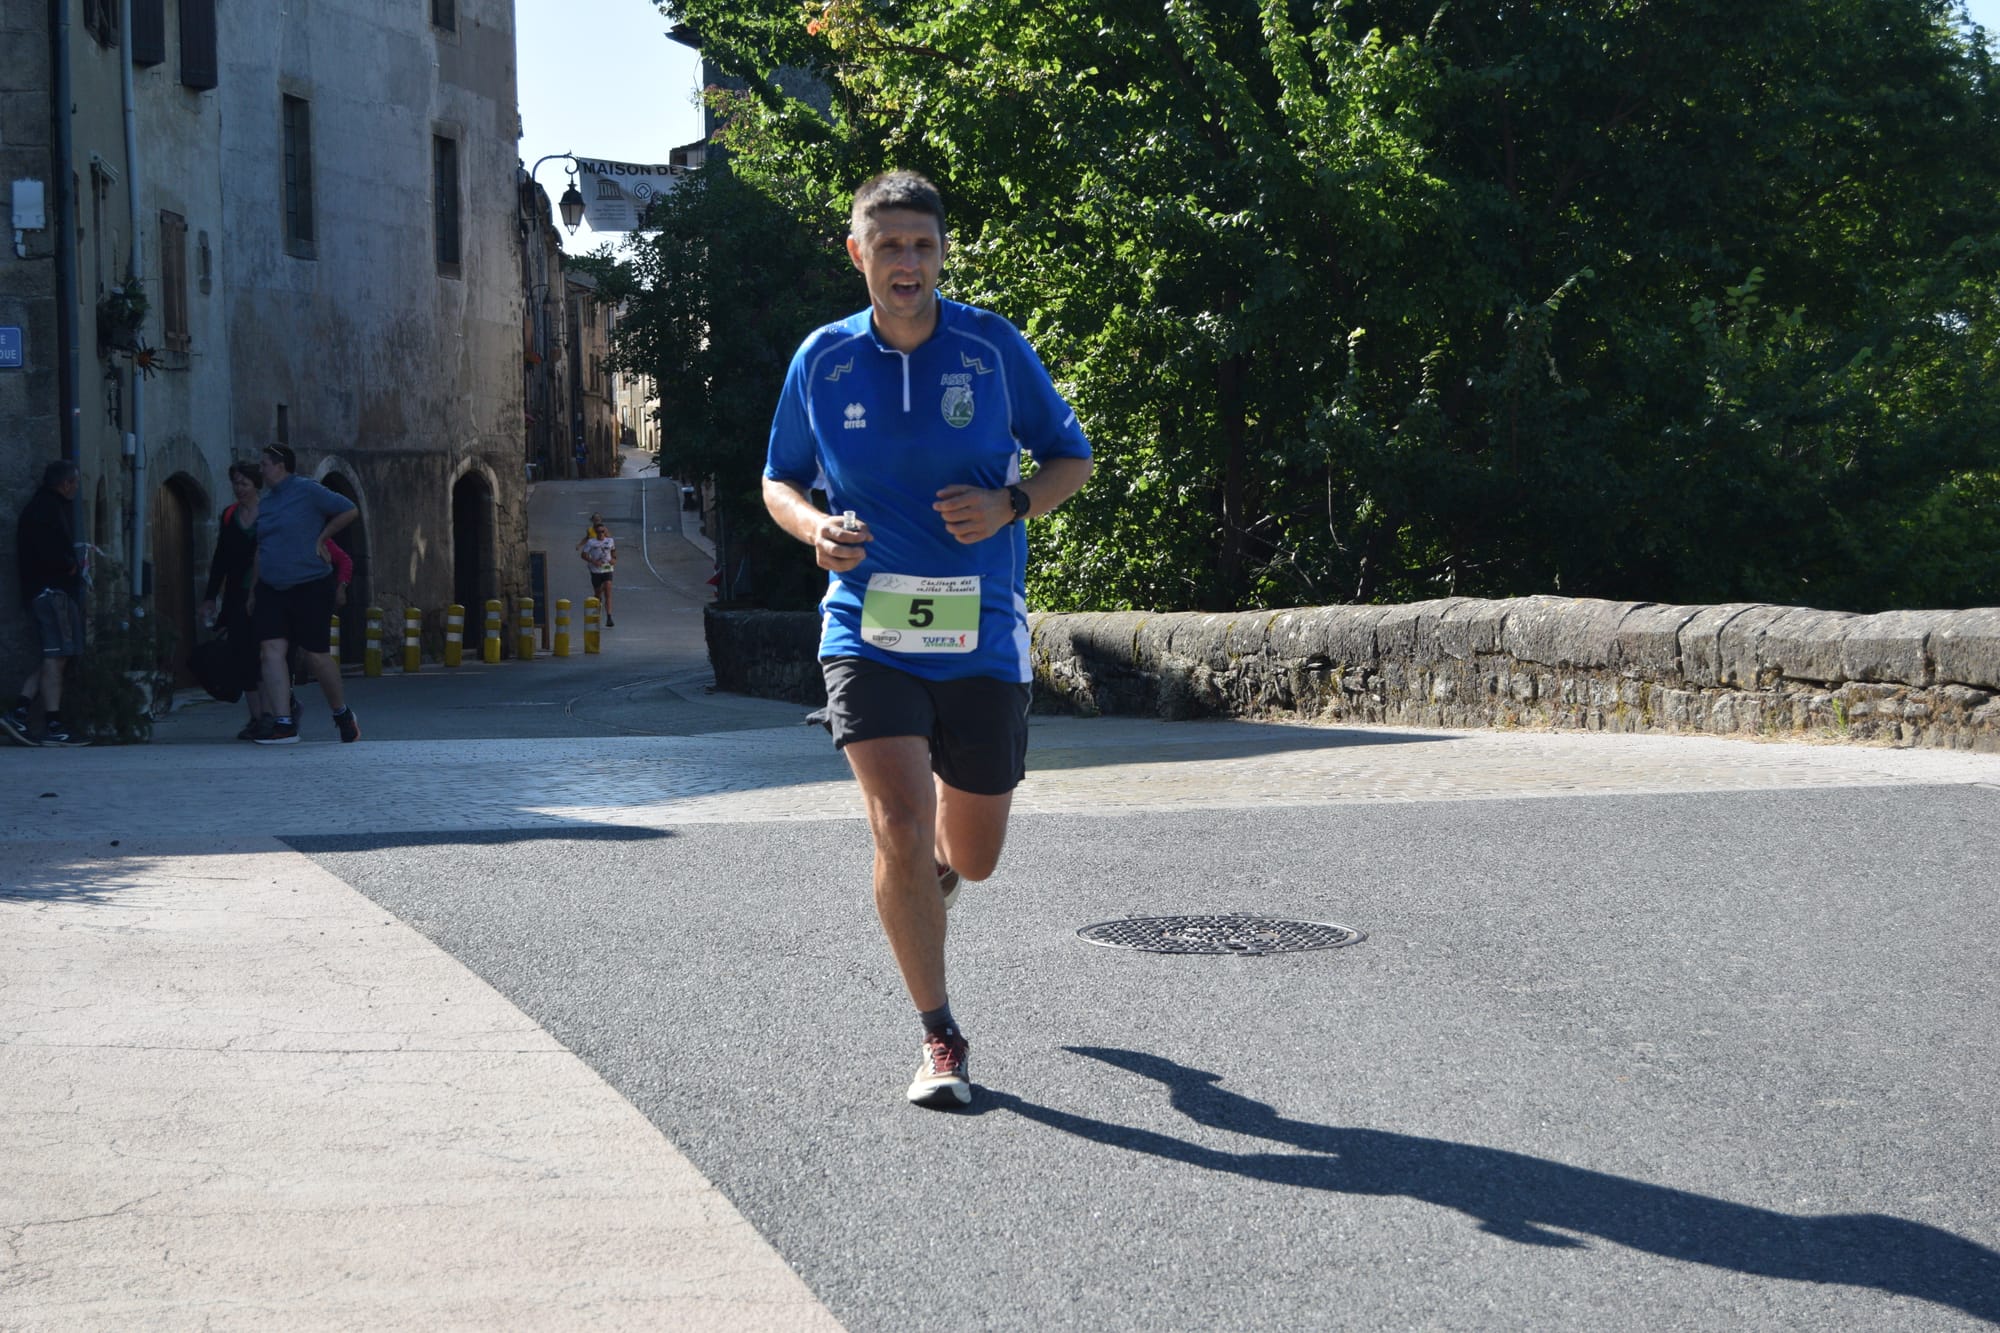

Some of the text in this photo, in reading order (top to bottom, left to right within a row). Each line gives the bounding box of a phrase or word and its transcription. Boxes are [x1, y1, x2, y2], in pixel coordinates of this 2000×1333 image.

[582, 162, 678, 175] MAISON DE
[940, 373, 972, 386] ASSP
[908, 599, 934, 628] 5
